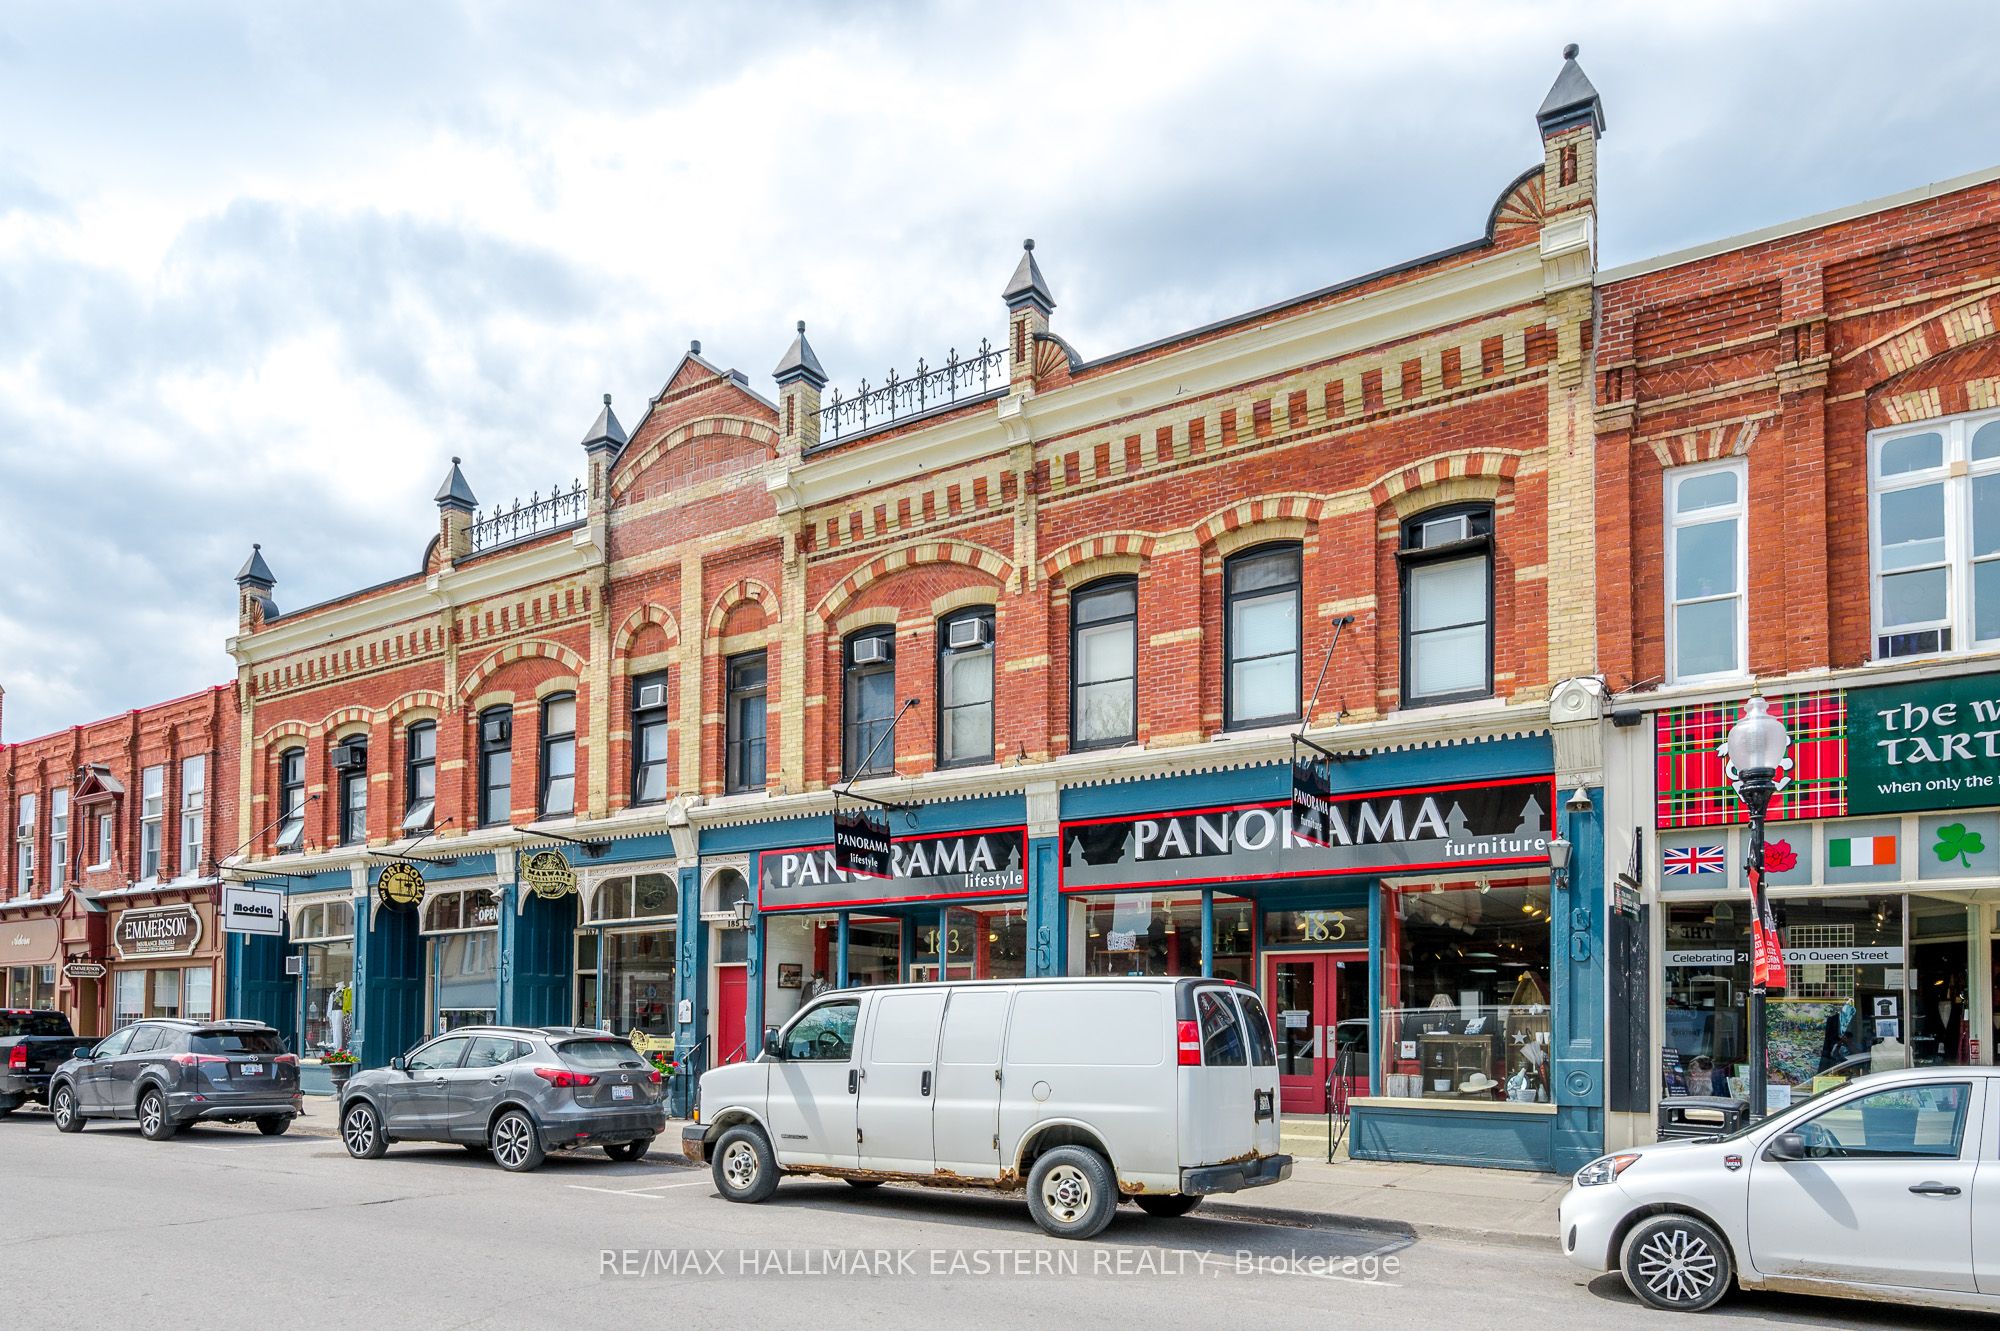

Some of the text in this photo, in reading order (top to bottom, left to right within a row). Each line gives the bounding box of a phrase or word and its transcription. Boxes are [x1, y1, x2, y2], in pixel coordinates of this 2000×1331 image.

[1877, 781, 1921, 794] when
[1926, 777, 1961, 791] only
[1965, 774, 1994, 788] the
[1293, 787, 1329, 816] PANORAMA
[837, 832, 889, 854] PANORAMA
[1445, 835, 1546, 857] furniture
[781, 836, 996, 887] PANRAMA
[850, 852, 878, 868] lifestyle
[379, 863, 401, 889] PORT
[403, 864, 425, 905] SOCIAL
[964, 872, 1023, 890] lifestyle
[233, 902, 273, 914] Modella
[478, 906, 499, 921] OPEN
[125, 917, 187, 940] EMMERSON
[727, 920, 740, 928] 185
[1300, 910, 1346, 941] 183
[1672, 952, 1733, 964] Celebrating
[1737, 953, 1749, 962] 21
[1789, 951, 1806, 961] On
[1809, 951, 1849, 962] Queen
[1851, 950, 1889, 960] Street
